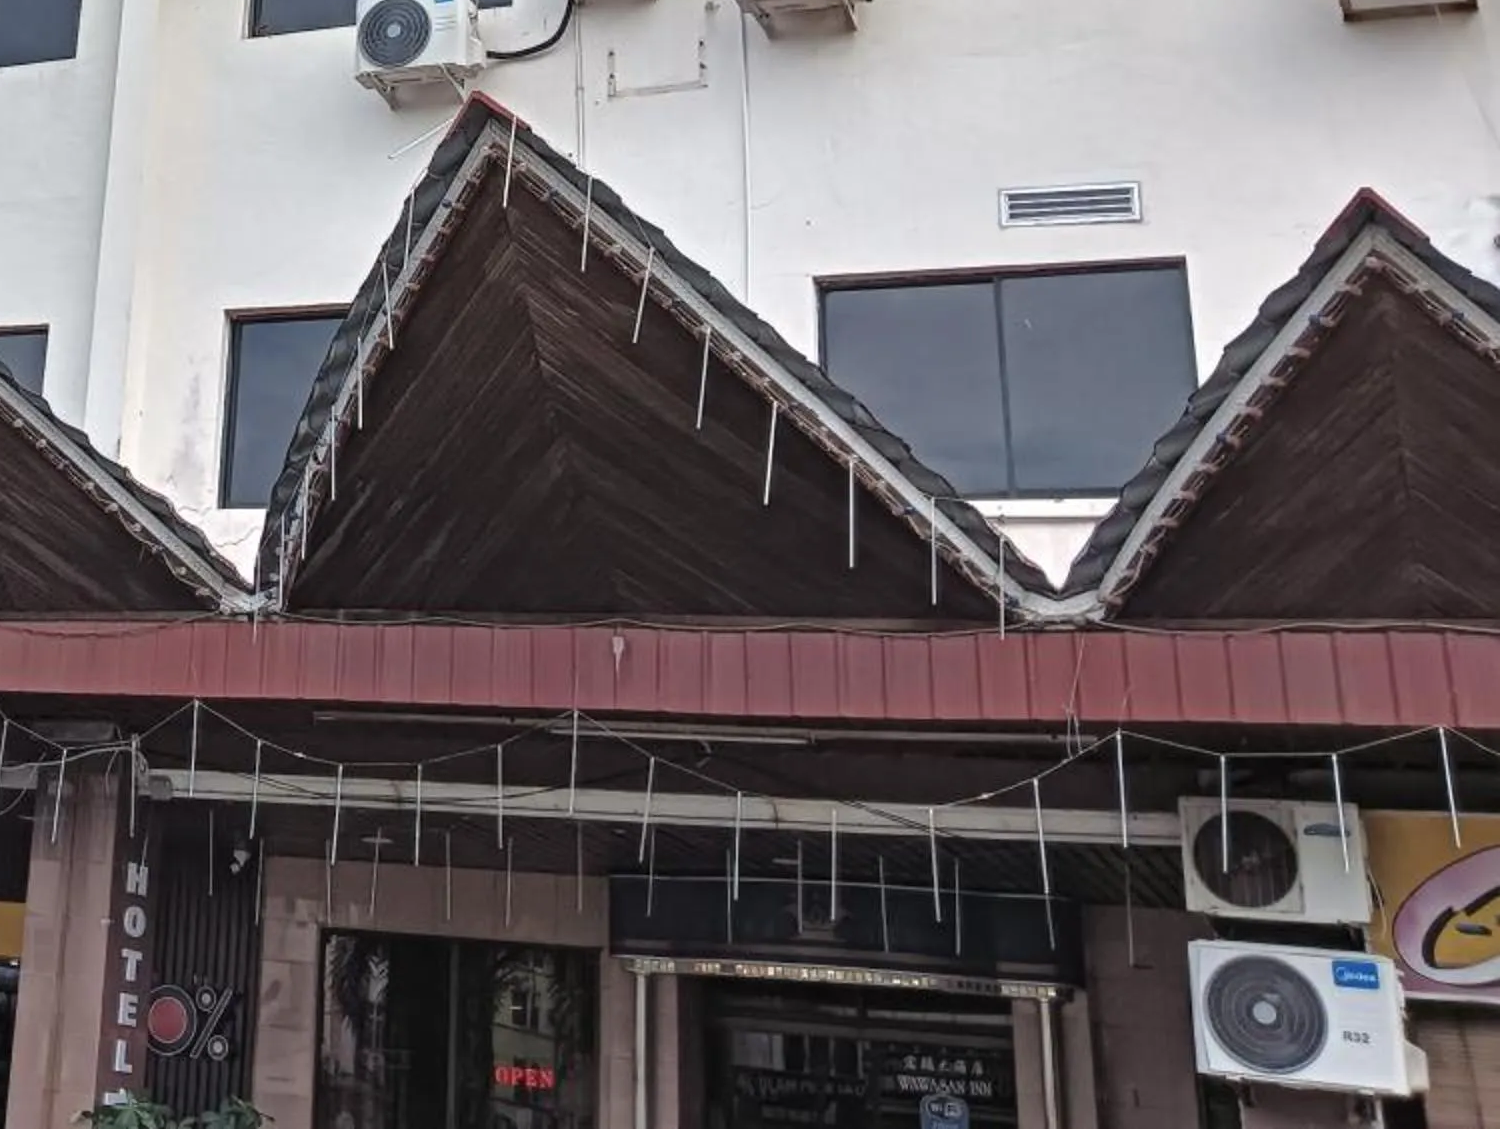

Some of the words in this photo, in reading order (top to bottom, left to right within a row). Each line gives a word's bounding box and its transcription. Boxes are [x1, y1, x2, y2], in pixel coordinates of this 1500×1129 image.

[114, 862, 149, 1074] HOTEL
[1342, 1029, 1371, 1045] R32
[495, 1065, 556, 1089] OPEN
